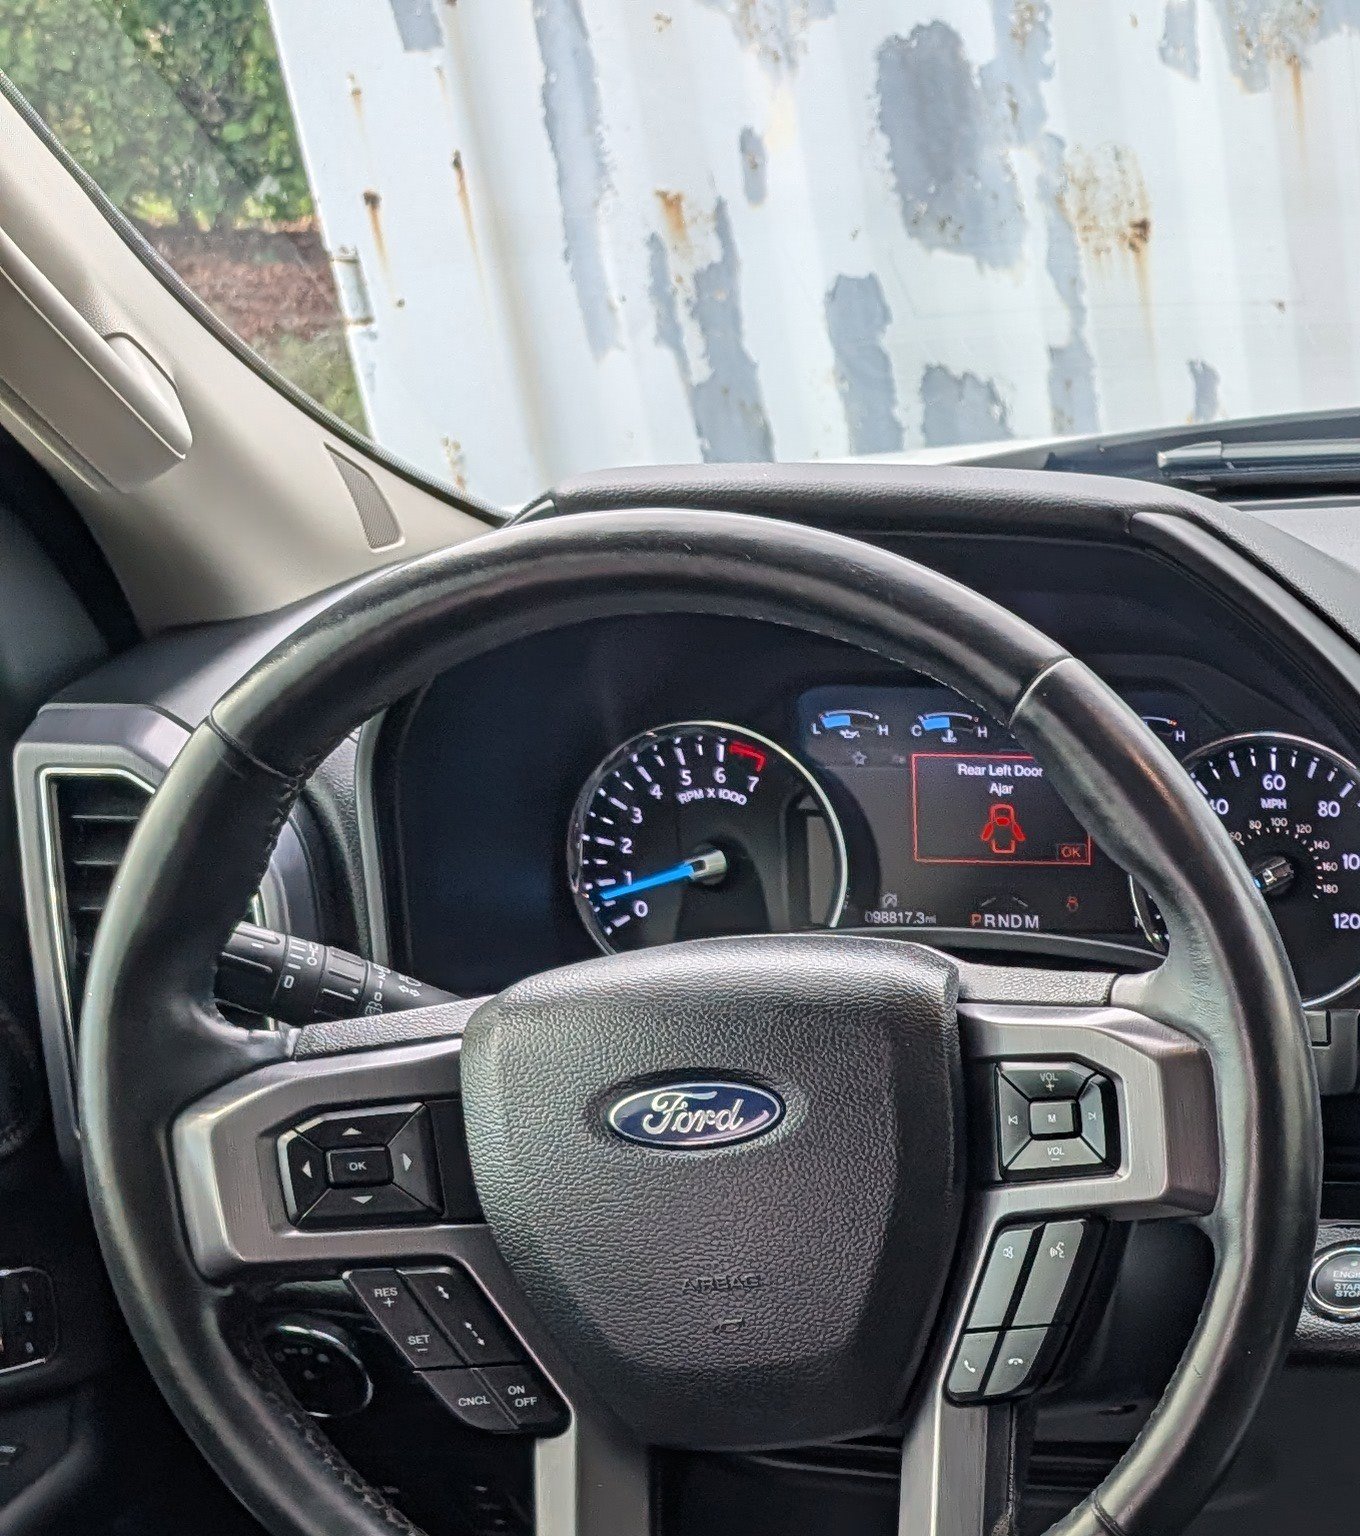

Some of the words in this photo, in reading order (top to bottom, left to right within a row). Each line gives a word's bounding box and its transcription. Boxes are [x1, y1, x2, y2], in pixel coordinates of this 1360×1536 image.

[877, 724, 889, 736] H
[910, 724, 922, 737] C
[977, 726, 988, 738] H
[1174, 730, 1186, 743] H
[679, 769, 692, 786] 5
[713, 766, 727, 784] 6
[957, 763, 986, 777] Rear
[988, 763, 1013, 777] Left
[1013, 764, 1043, 778] Door
[747, 774, 760, 792] 7
[989, 782, 1014, 797] Ajar
[1262, 774, 1286, 791] 60
[649, 784, 663, 800] 4
[677, 788, 704, 804] RPM
[718, 788, 747, 806] 1000
[1260, 797, 1287, 810] MPH
[1317, 801, 1341, 818] 80
[630, 806, 643, 824] 3
[1270, 817, 1288, 827] 100
[1249, 819, 1262, 830] 80
[1295, 823, 1312, 835] 120
[620, 837, 633, 854] 2
[1061, 845, 1081, 859] OK
[1313, 840, 1330, 851] 140
[1321, 861, 1338, 872] 160
[624, 870, 632, 886] 1
[1322, 883, 1339, 894] 180
[633, 900, 648, 918] 0
[1039, 1071, 1059, 1083] VOL
[641, 1090, 745, 1136] Ford
[1047, 1113, 1057, 1123] M
[1046, 1146, 1066, 1157] VOL
[348, 1160, 367, 1172] OK
[373, 1286, 398, 1299] RES
[407, 1333, 431, 1347] SET
[507, 1384, 525, 1396] ON
[457, 1394, 491, 1408] CNCL
[514, 1396, 538, 1409] OFF
